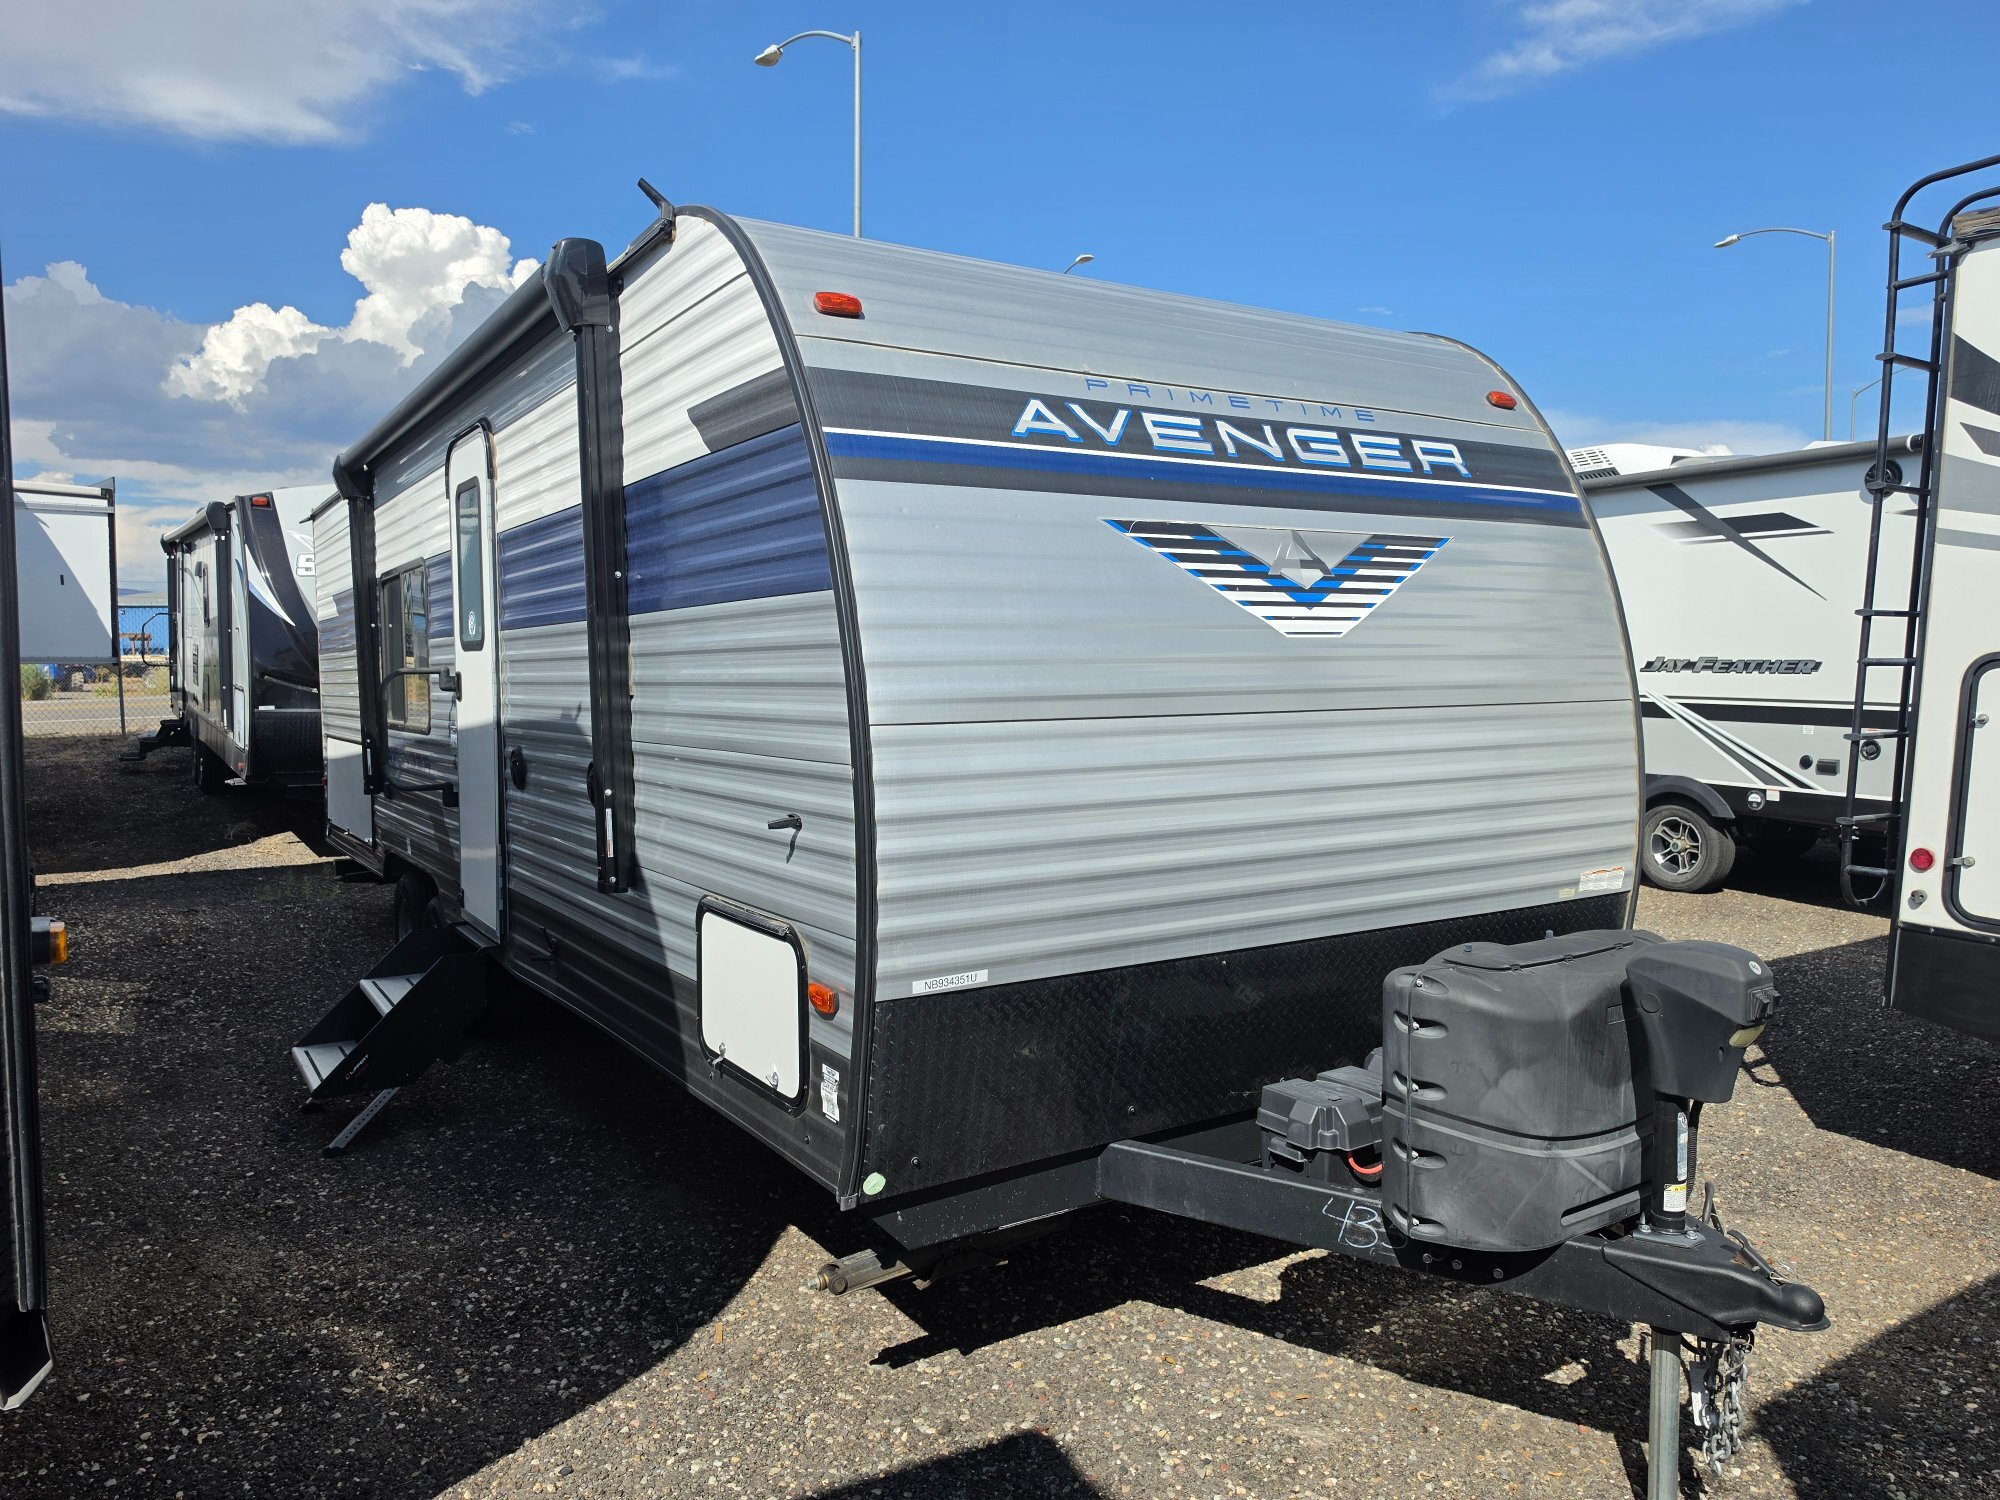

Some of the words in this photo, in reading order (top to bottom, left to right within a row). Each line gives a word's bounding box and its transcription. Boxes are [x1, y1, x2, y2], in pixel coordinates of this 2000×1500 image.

[1085, 378, 1375, 422] PRIMETIME
[1012, 398, 1472, 477] AVENGER
[1640, 656, 1690, 673] JAY
[1693, 656, 1823, 674] FEATHER
[924, 973, 978, 991] NB934351U
